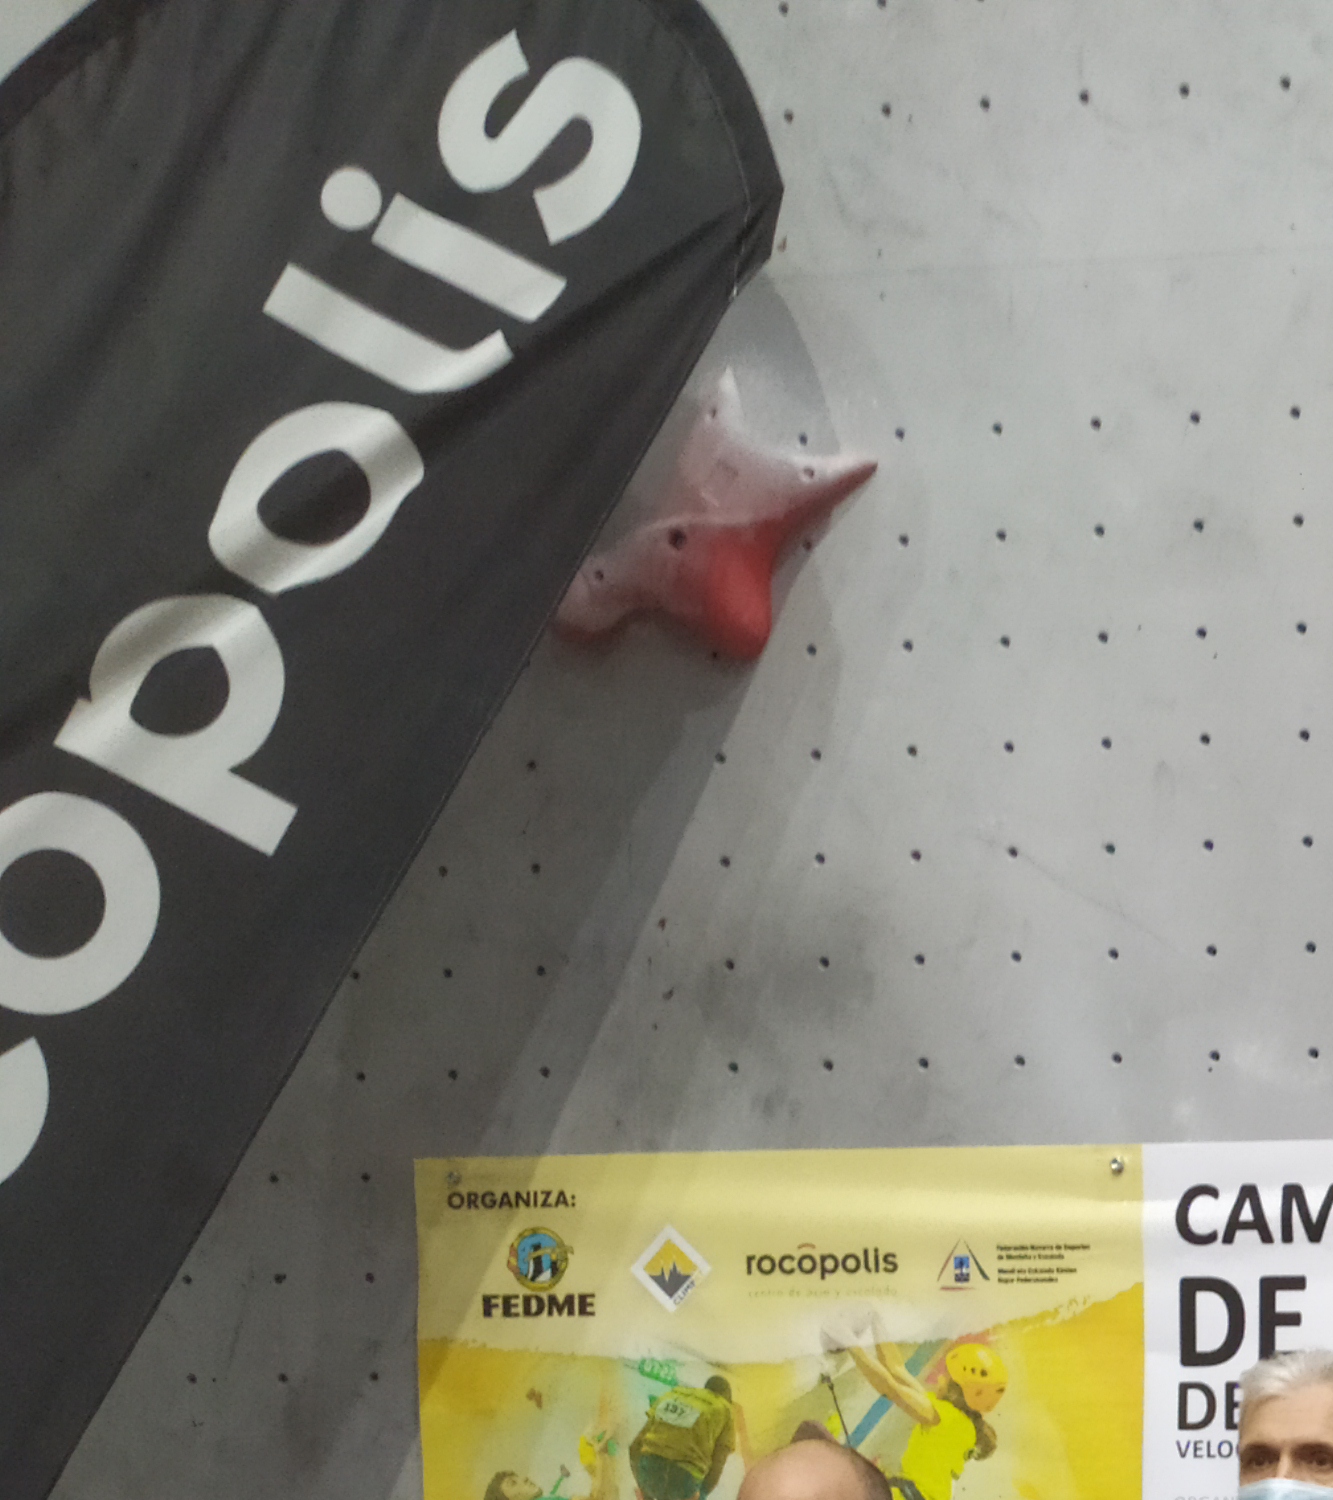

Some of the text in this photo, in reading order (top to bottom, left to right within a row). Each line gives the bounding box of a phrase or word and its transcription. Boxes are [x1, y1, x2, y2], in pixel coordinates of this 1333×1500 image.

[447, 1190, 576, 1210] ORGANIZA:
[482, 1293, 596, 1318] FEDME
[1179, 1276, 1306, 1368] DE
